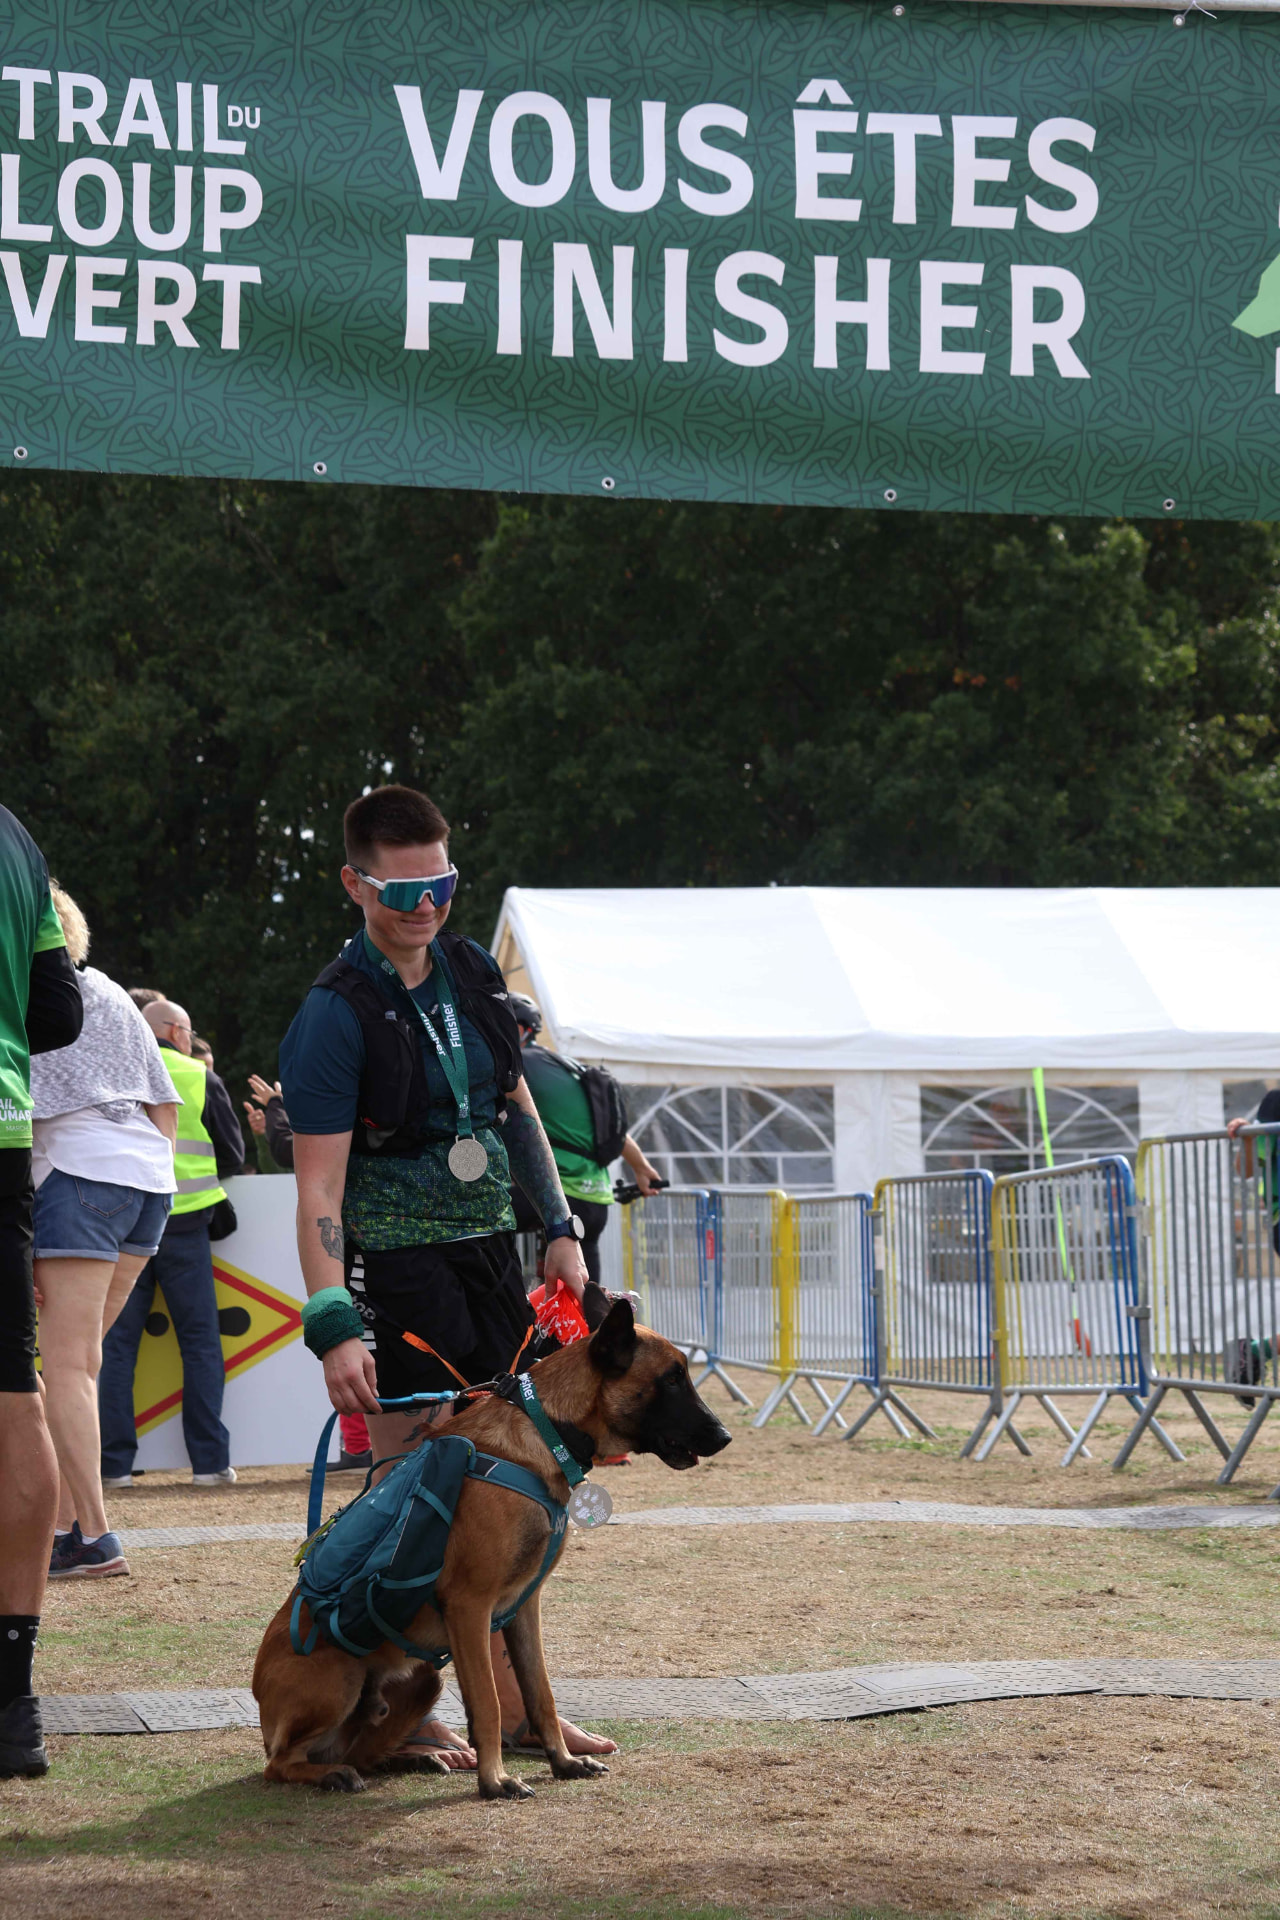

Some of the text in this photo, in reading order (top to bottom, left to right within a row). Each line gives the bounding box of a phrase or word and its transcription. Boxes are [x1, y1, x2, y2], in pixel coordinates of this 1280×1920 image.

[1, 65, 262, 156] TRAIL DU
[392, 78, 1100, 234] VOUS ÊTES
[0, 153, 264, 254] LOUP
[0, 250, 263, 350] VERT
[404, 233, 1092, 379] FINISHER
[442, 1003, 462, 1048] Finisher
